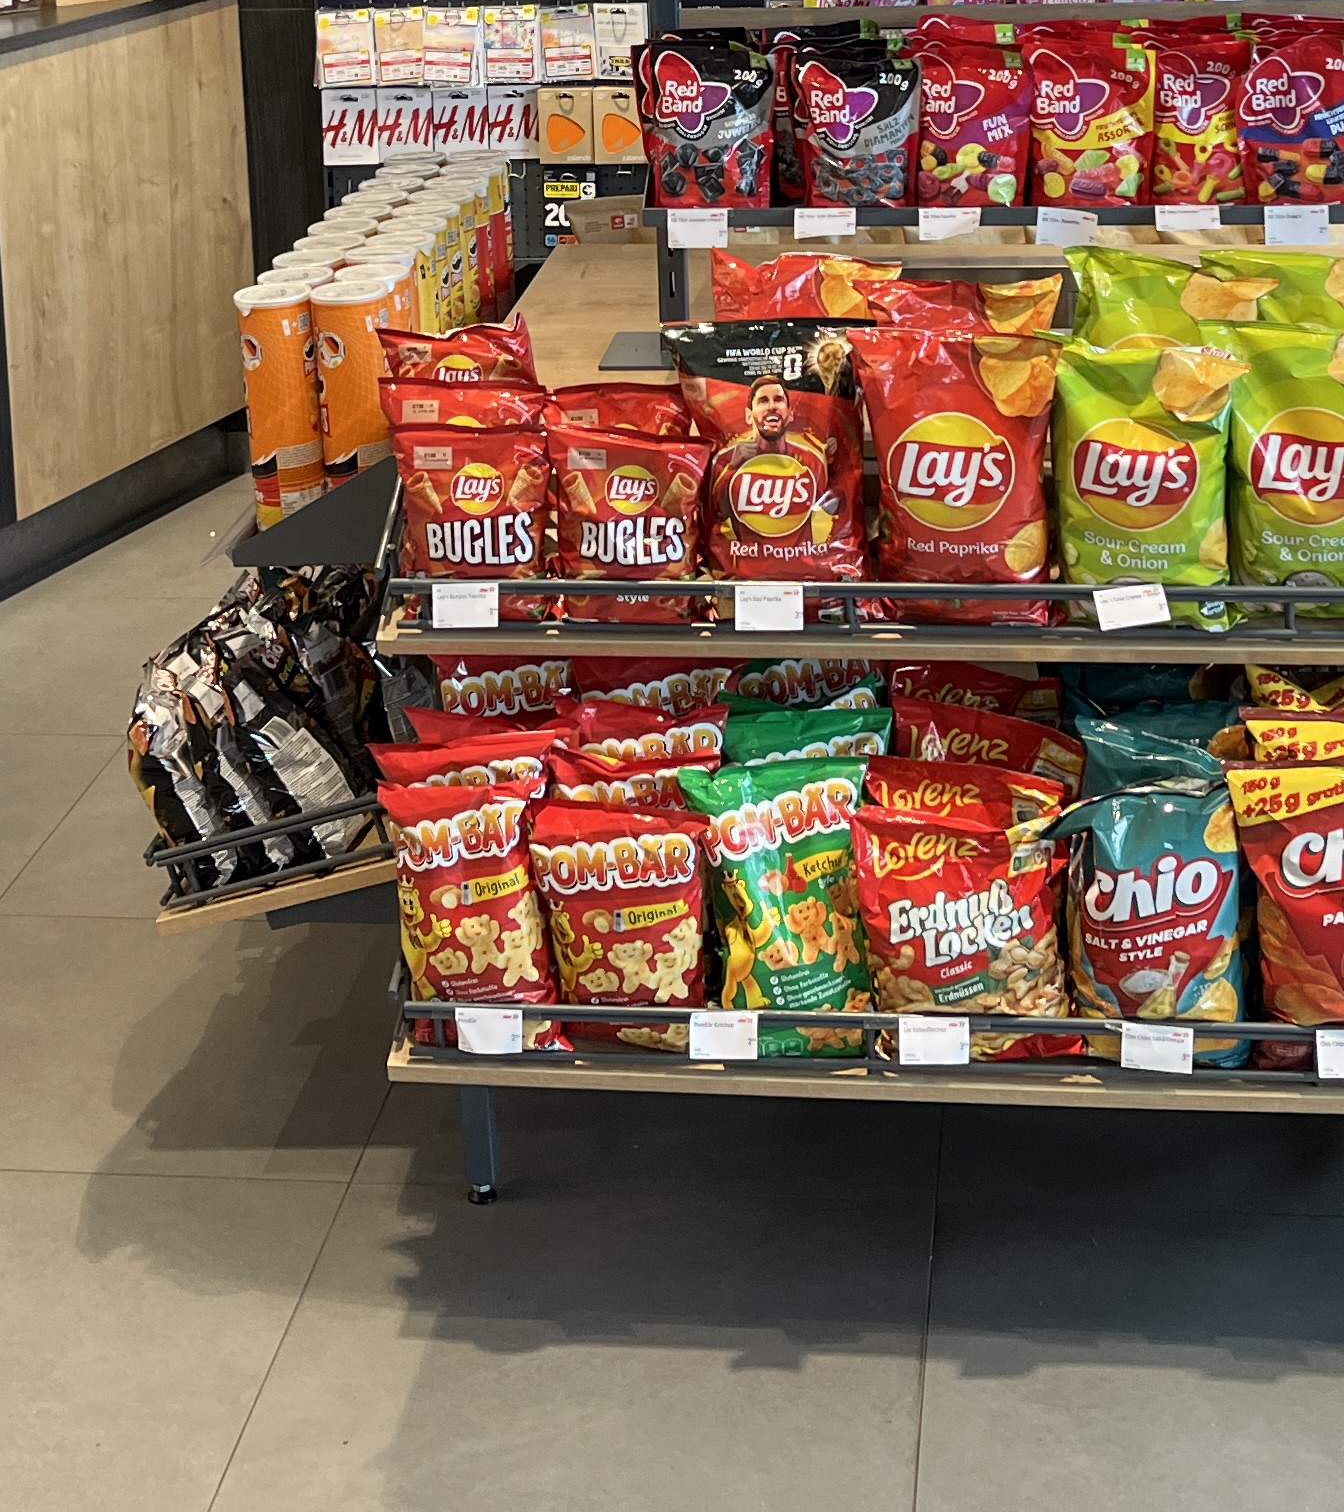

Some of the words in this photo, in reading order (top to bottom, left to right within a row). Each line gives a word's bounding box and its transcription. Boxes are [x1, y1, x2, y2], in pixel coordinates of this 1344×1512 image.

[665, 80, 698, 97] Red
[923, 80, 951, 97] Red
[1043, 80, 1074, 97] Red
[1163, 74, 1194, 91] Red
[662, 95, 703, 114] Band
[811, 90, 843, 106] Red
[1037, 97, 1081, 114] Band
[1159, 90, 1201, 109] Band
[1254, 92, 1296, 110] Band
[433, 105, 488, 146] H&M
[488, 103, 539, 143] H&M
[810, 106, 850, 124] Band
[982, 114, 1007, 132] FUN
[323, 108, 377, 149] H&M
[378, 107, 433, 148] H&M
[987, 127, 1013, 143] MIX
[545, 184, 578, 192] PREPAID
[743, 347, 769, 356] WORLD
[771, 347, 785, 355] CUP
[897, 442, 1006, 507] Lay's
[1079, 442, 1189, 507] Lay's
[455, 475, 502, 502] Lay's
[609, 476, 656, 504] Lay's
[737, 472, 811, 519] Lay's
[427, 512, 534, 565] BUGLES
[581, 516, 686, 565] BUGLES
[939, 539, 999, 556] Paprika
[1083, 530, 1125, 550] Sour
[1129, 535, 1186, 555] Cream
[1261, 530, 1304, 548] Sour
[762, 541, 829, 560] Paprika
[1100, 550, 1113, 565] &
[1117, 550, 1168, 570] Onion
[1279, 546, 1293, 562] &
[1242, 778, 1267, 793] 150
[706, 779, 859, 862] POM-BÄR
[532, 834, 697, 894] POM-BÄR
[871, 831, 979, 879] Lorenz
[474, 875, 520, 897] Original
[1084, 859, 1219, 923] Chio
[627, 904, 678, 926] Original
[889, 879, 1013, 944] Erdnuß
[923, 903, 1035, 967] Locken
[1085, 932, 1119, 950] SALT
[1121, 934, 1132, 948] &
[1134, 920, 1208, 944] VINEGAR
[1118, 946, 1163, 962] STYLE
[940, 960, 973, 979] Classic
[938, 982, 985, 1004] Erdnüssen
